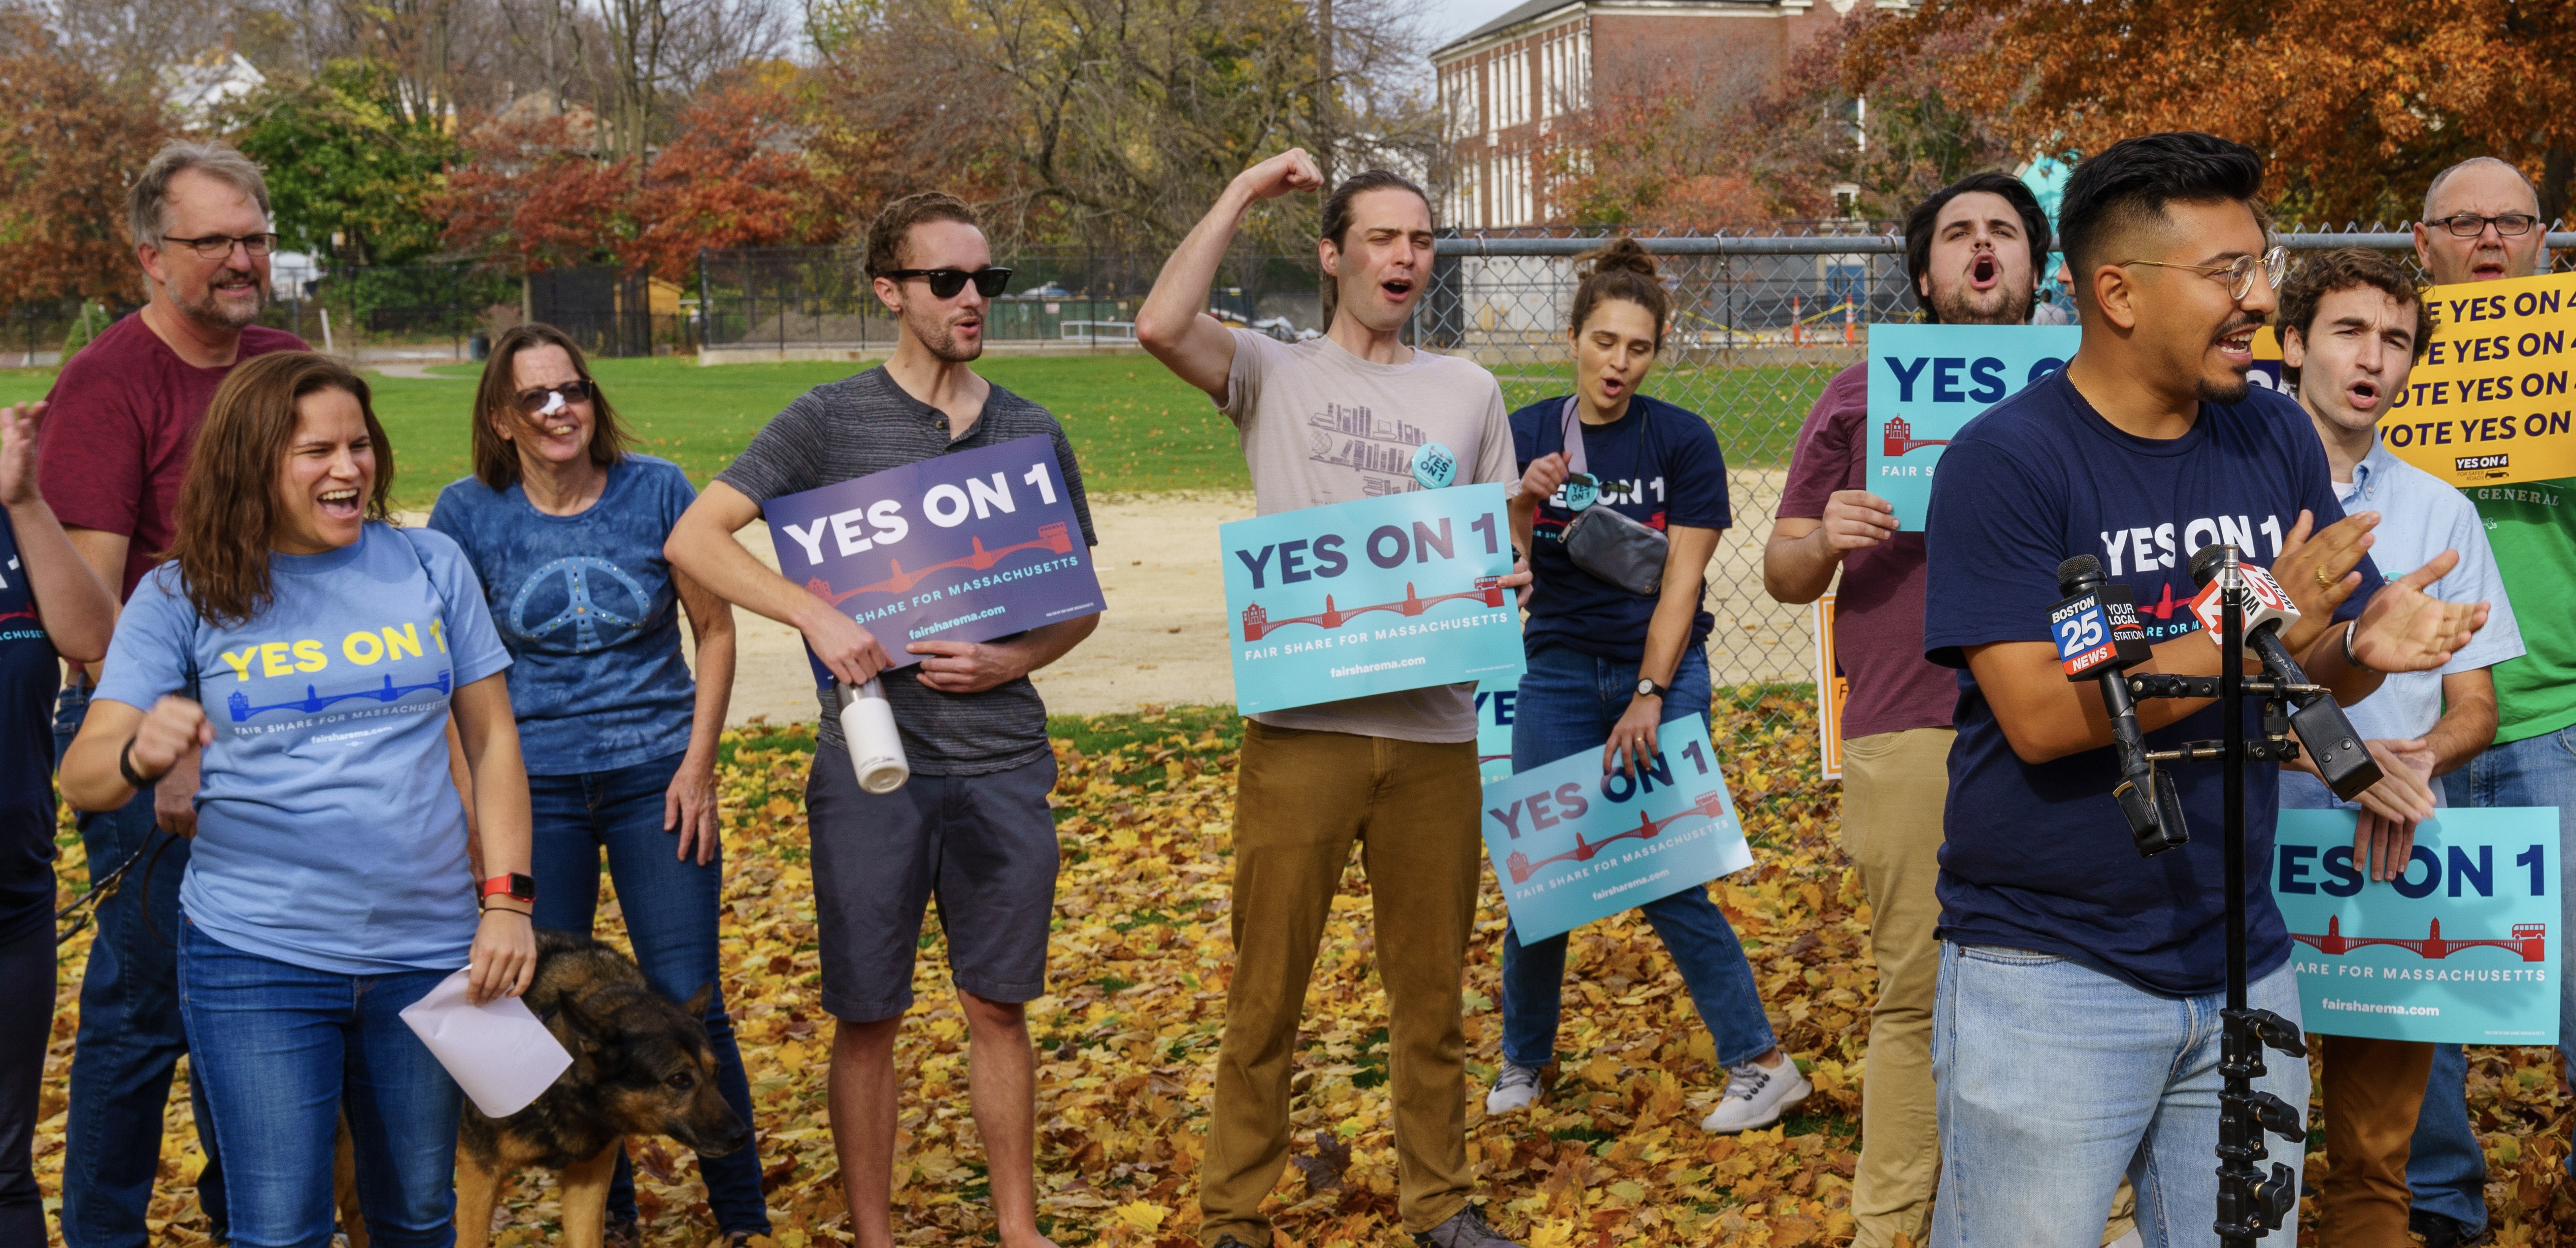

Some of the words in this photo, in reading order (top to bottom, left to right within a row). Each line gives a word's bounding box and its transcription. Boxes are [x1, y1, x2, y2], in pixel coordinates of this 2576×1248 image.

[2449, 295, 2507, 323] YES
[2514, 289, 2561, 316] ON
[2453, 336, 2510, 363] YES
[2517, 330, 2565, 357] ON
[1883, 356, 2007, 404] YES
[2391, 381, 2449, 408] TE
[2456, 376, 2513, 403] YES
[2520, 371, 2568, 397] ON
[2460, 416, 2517, 443] YES
[2524, 410, 2572, 437] ON
[1420, 461, 1438, 477] ON
[1439, 473, 1444, 481] 1
[1427, 450, 1449, 473] YES
[1882, 465, 1917, 476] FAIR
[2456, 457, 2478, 469] YES
[2480, 456, 2498, 468] ON
[2500, 456, 2507, 466] 4
[1650, 476, 1665, 502] 1
[2477, 488, 2560, 506] GENERAL
[782, 499, 909, 566] YES
[923, 471, 1016, 528] ON
[1023, 462, 1057, 506] 1
[1235, 534, 1348, 590] YES
[1366, 517, 1455, 569] ON
[1471, 512, 1499, 554] 1
[2101, 523, 2175, 576] YES
[2184, 515, 2256, 559] ON
[2260, 515, 2283, 558] 1
[855, 601, 906, 624] SHARE
[911, 590, 942, 607] FOR
[948, 556, 1079, 597] MASSACHUSETTS
[2239, 579, 2260, 616] WC
[2262, 573, 2296, 609] WCVB
[908, 604, 1006, 640] fairsharema.com
[2052, 595, 2095, 624] BOSTON
[2107, 603, 2134, 615] YOUR
[2108, 614, 2140, 625] LOCAL
[220, 639, 328, 681] YES
[342, 622, 423, 666] ON
[429, 618, 446, 653] 1
[1245, 646, 1278, 661] FAIR
[1284, 638, 1333, 655] SHARE
[1339, 633, 1368, 646] FOR
[1375, 612, 1508, 641] MASSACHUSETTS
[2061, 609, 2103, 658] 25
[2113, 630, 2145, 641] STATION
[1330, 656, 1426, 678] fairsharema.com
[2072, 647, 2108, 672] NEWS
[234, 726, 263, 736] FAIR
[267, 718, 313, 733] SHARE
[319, 713, 345, 725] FOR
[311, 725, 393, 745] fairsharema.com
[1488, 781, 1589, 841] YES
[1600, 751, 1674, 804] ON
[1681, 740, 1708, 776] 1
[1515, 883, 1545, 901] FAIR
[1548, 867, 1590, 889] SHARE
[1594, 858, 1619, 874] FOR
[1622, 819, 1729, 864] MASSACHUSETTS
[2274, 843, 2365, 898] ES
[2391, 844, 2493, 899] ON
[2516, 844, 2545, 896] 1
[1592, 868, 1670, 901] fairsharema.com
[2295, 961, 2329, 975] ARE
[2339, 965, 2374, 978] FOR
[2383, 968, 2545, 982] MASSACHUSETTS
[2322, 998, 2440, 1017] fairsharema.com
